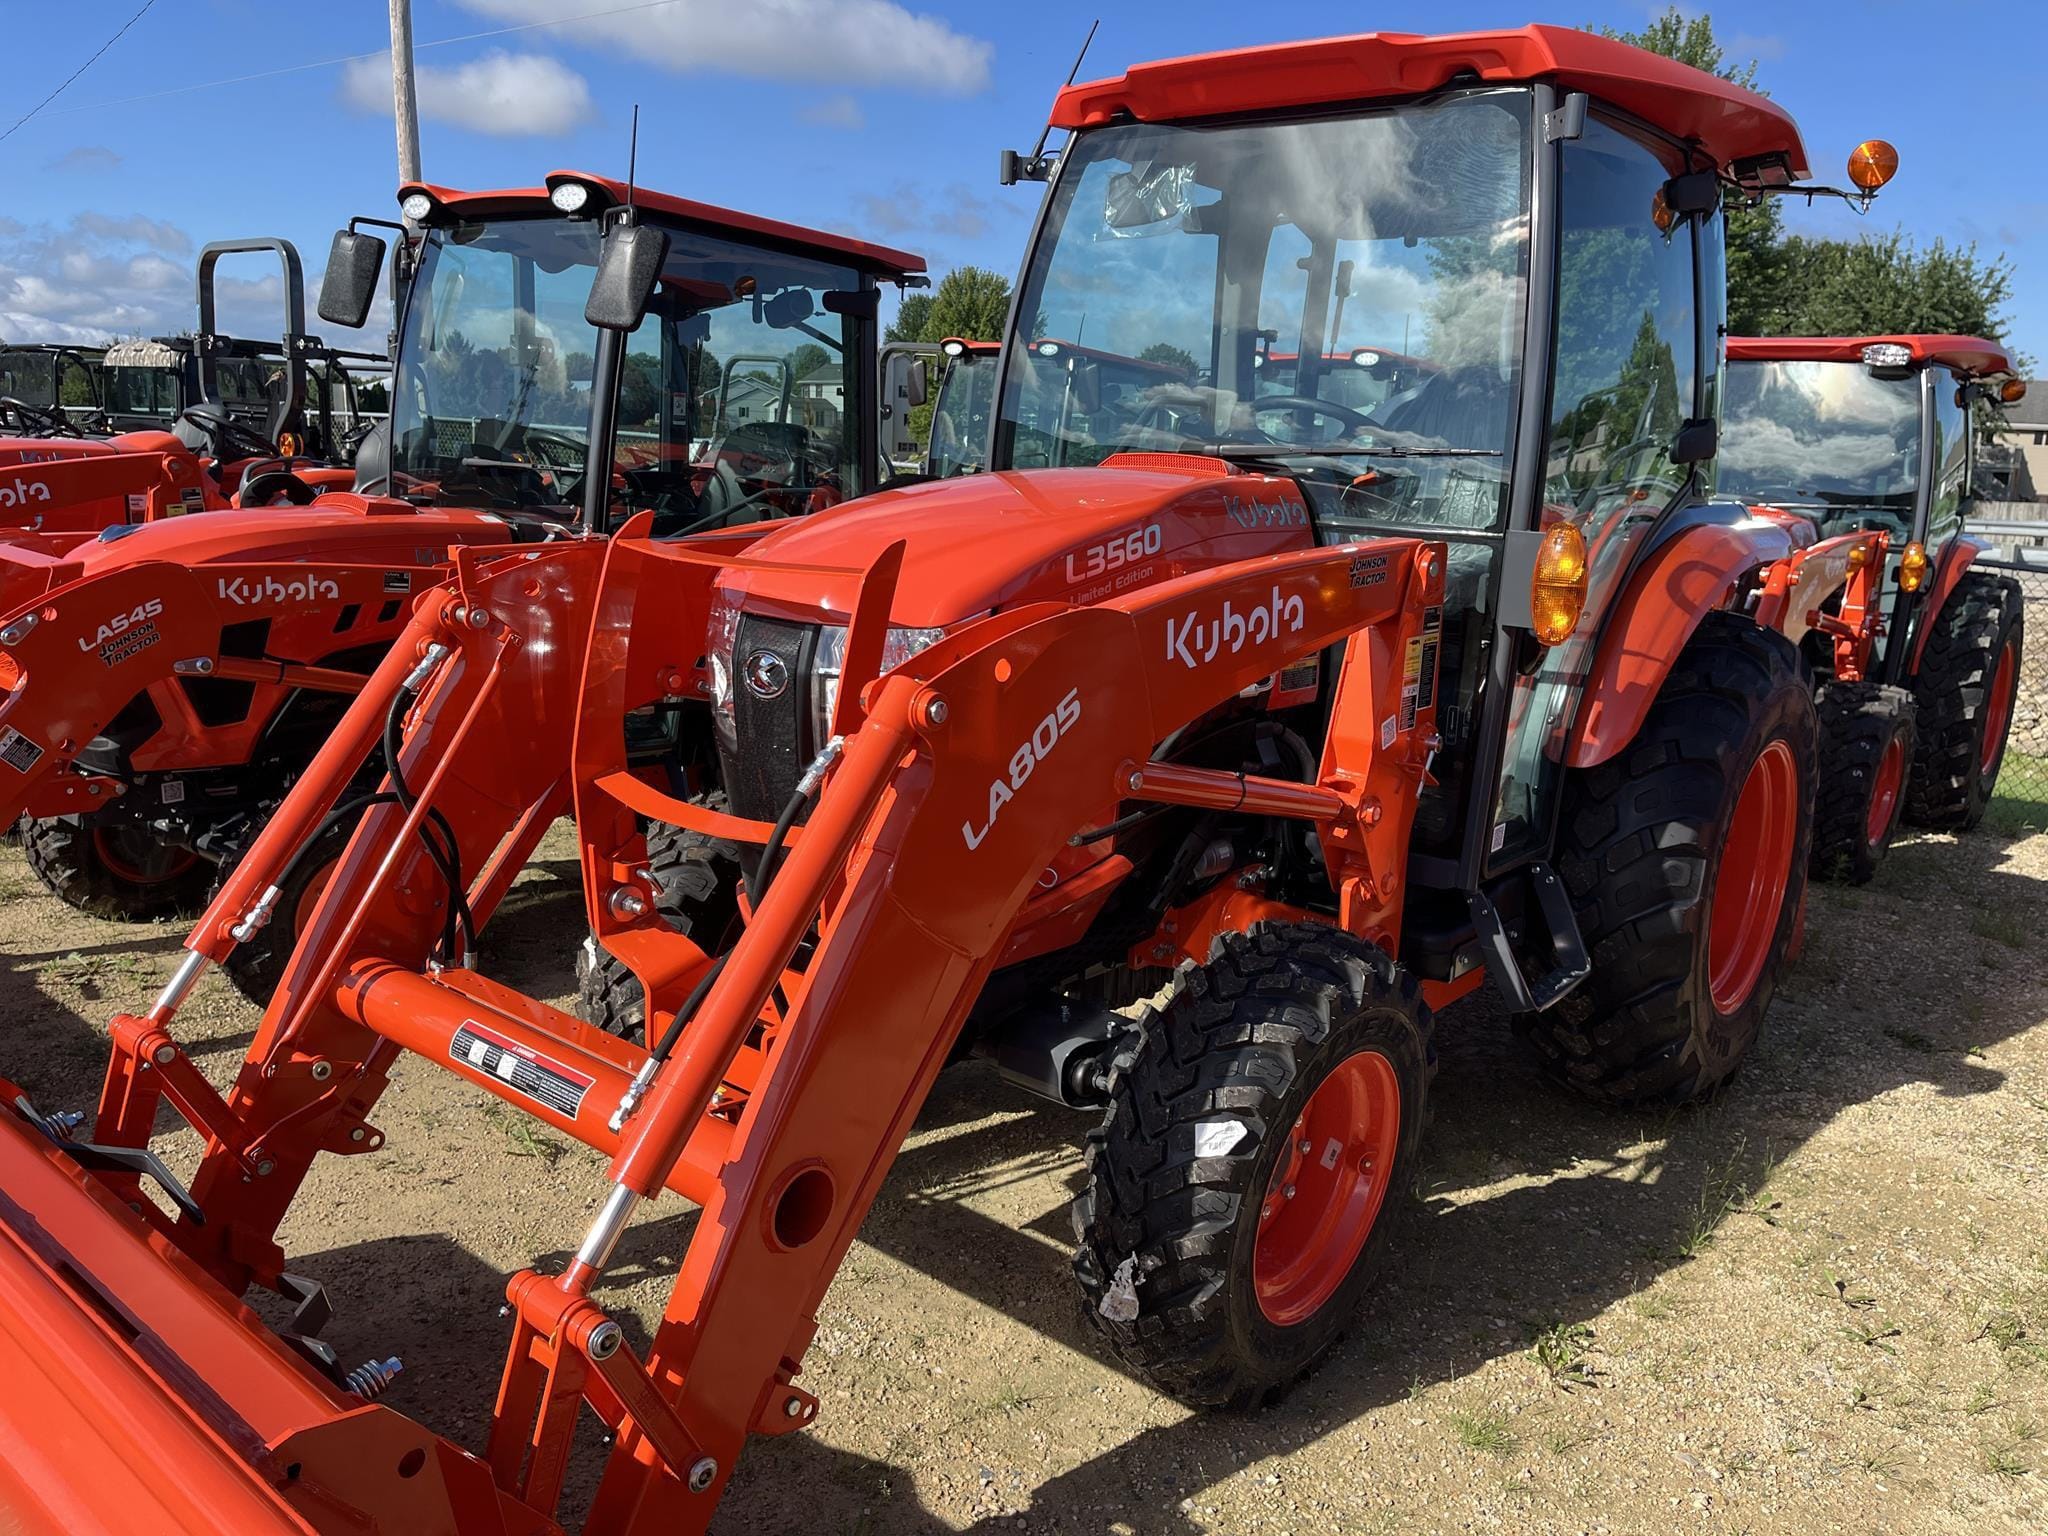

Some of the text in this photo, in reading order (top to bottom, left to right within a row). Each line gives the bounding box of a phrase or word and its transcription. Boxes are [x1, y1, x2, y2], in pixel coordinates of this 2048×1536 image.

[1223, 496, 1307, 528] Kubota
[1066, 524, 1161, 584] L3560
[1349, 556, 1388, 573] JOHNSON
[218, 574, 339, 605] Kubota
[1070, 565, 1153, 606] Limited Edition
[1349, 572, 1386, 588] TRACTOR
[78, 598, 163, 652] LA545
[99, 621, 155, 658] JOHNSON
[1167, 585, 1304, 669] Kubota
[104, 633, 161, 667] TRACTOR
[962, 687, 1081, 850] LA805
